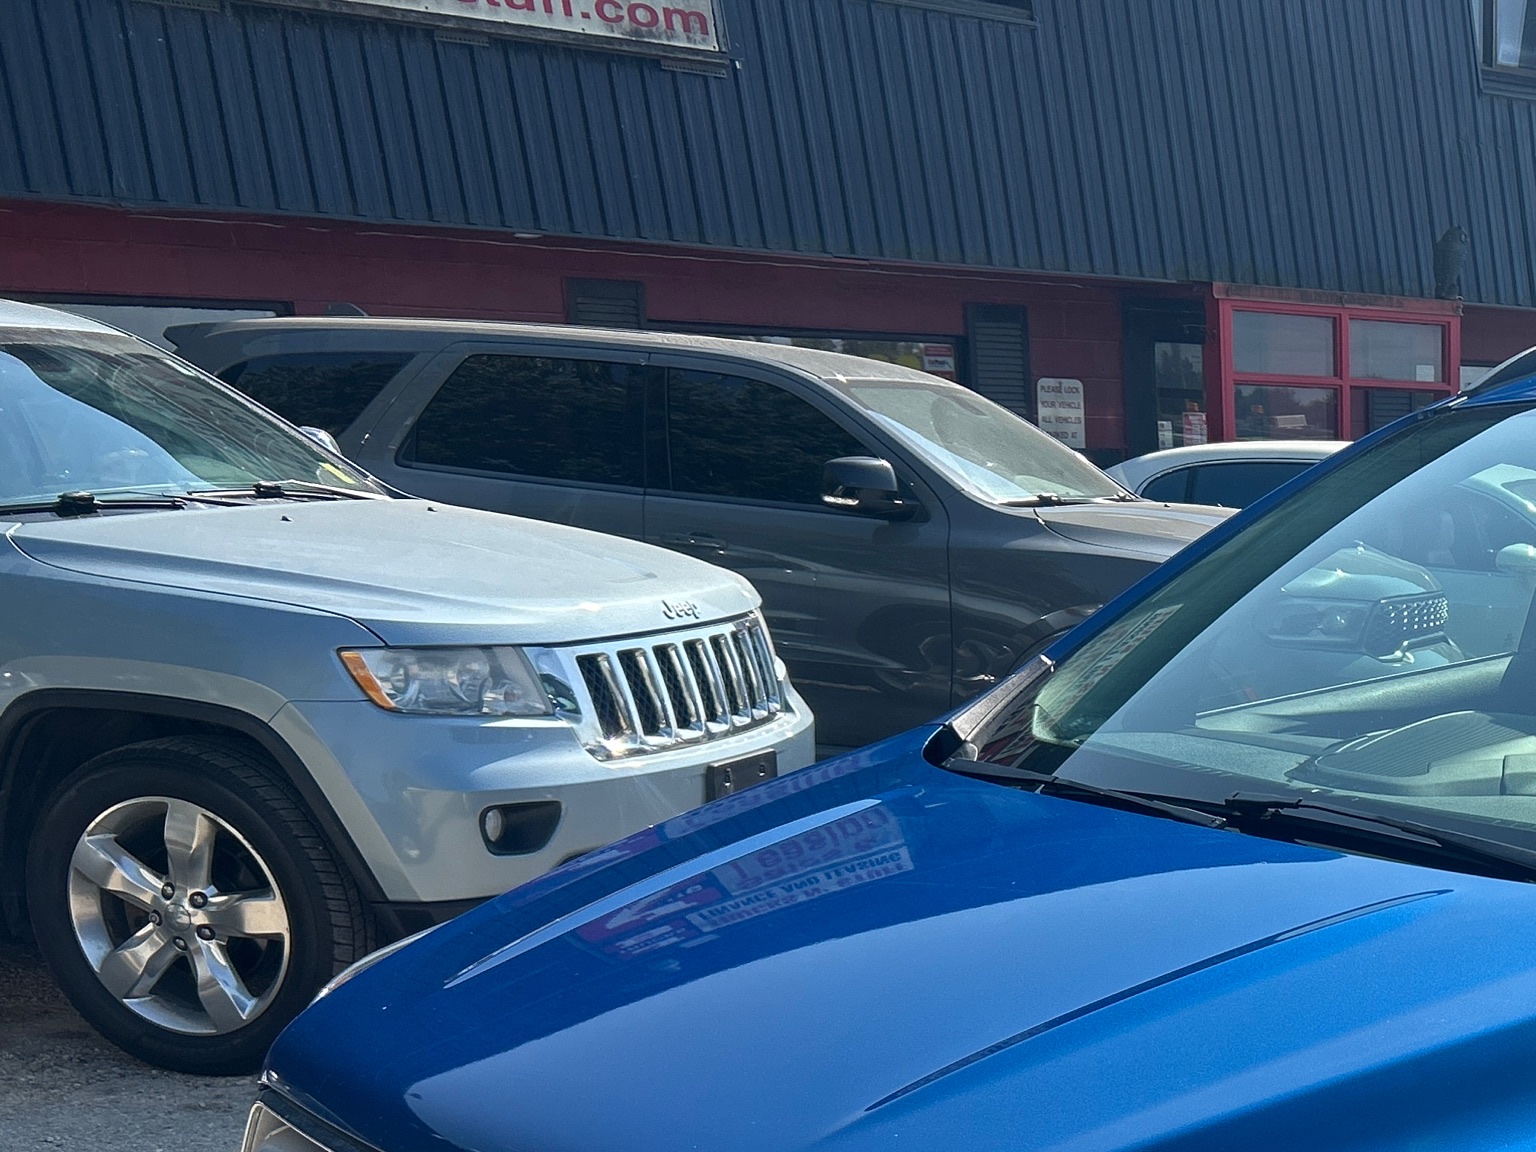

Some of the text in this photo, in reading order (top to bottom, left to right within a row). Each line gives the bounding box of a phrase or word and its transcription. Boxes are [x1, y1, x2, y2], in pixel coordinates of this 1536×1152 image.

[1041, 385, 1080, 394] PLEASE LOCK
[1055, 416, 1081, 424] VEHICLES
[662, 600, 699, 619] Jeep
